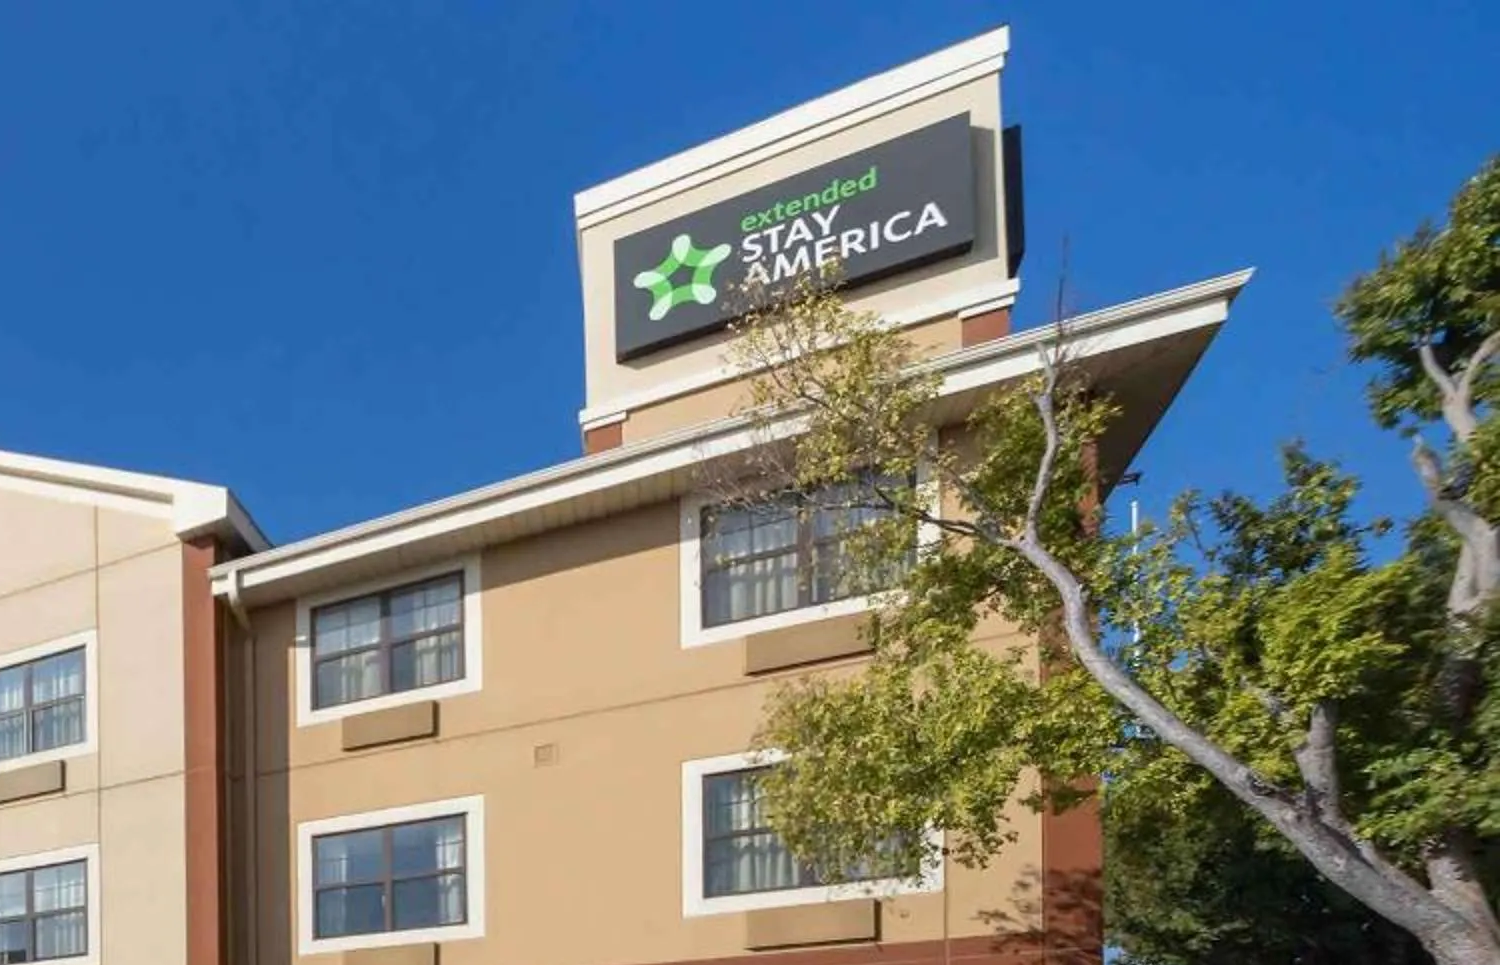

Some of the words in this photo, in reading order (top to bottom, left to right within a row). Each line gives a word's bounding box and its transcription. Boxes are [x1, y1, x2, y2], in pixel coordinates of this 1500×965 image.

[740, 165, 878, 232] extended
[741, 204, 841, 263] STAY
[745, 201, 948, 286] AMERICA
